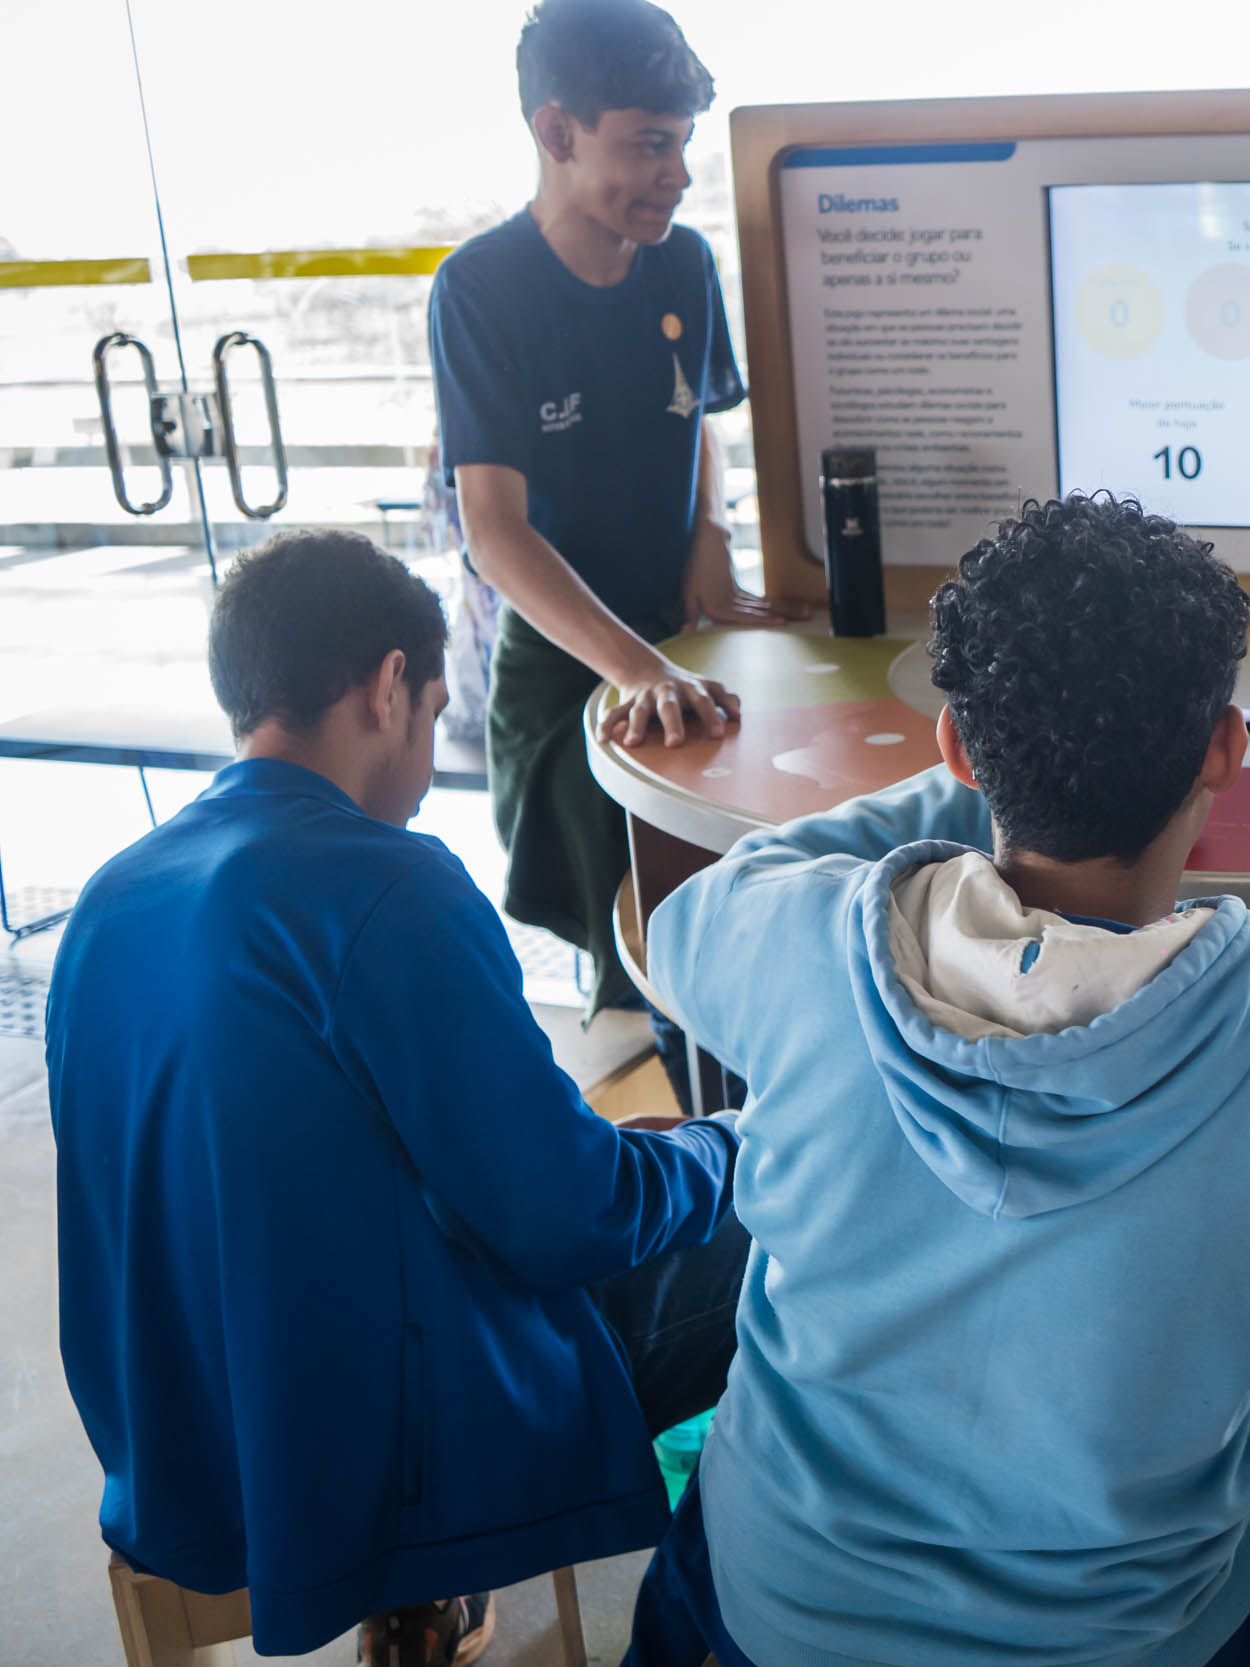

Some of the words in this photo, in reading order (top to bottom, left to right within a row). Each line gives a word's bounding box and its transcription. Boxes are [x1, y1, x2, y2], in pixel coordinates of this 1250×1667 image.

[818, 194, 899, 213] Dilemas
[817, 228, 851, 242] Você
[909, 228, 944, 244] jogar
[950, 228, 983, 242] para
[821, 250, 888, 264] beneficiar
[893, 253, 901, 262] o
[907, 252, 948, 266] grupo
[953, 251, 970, 262] ou
[823, 273, 870, 288] apenas
[901, 270, 959, 284] mesmo?
[1109, 300, 1130, 328] 0
[1221, 300, 1241, 328] 0
[1154, 446, 1202, 480] 10
